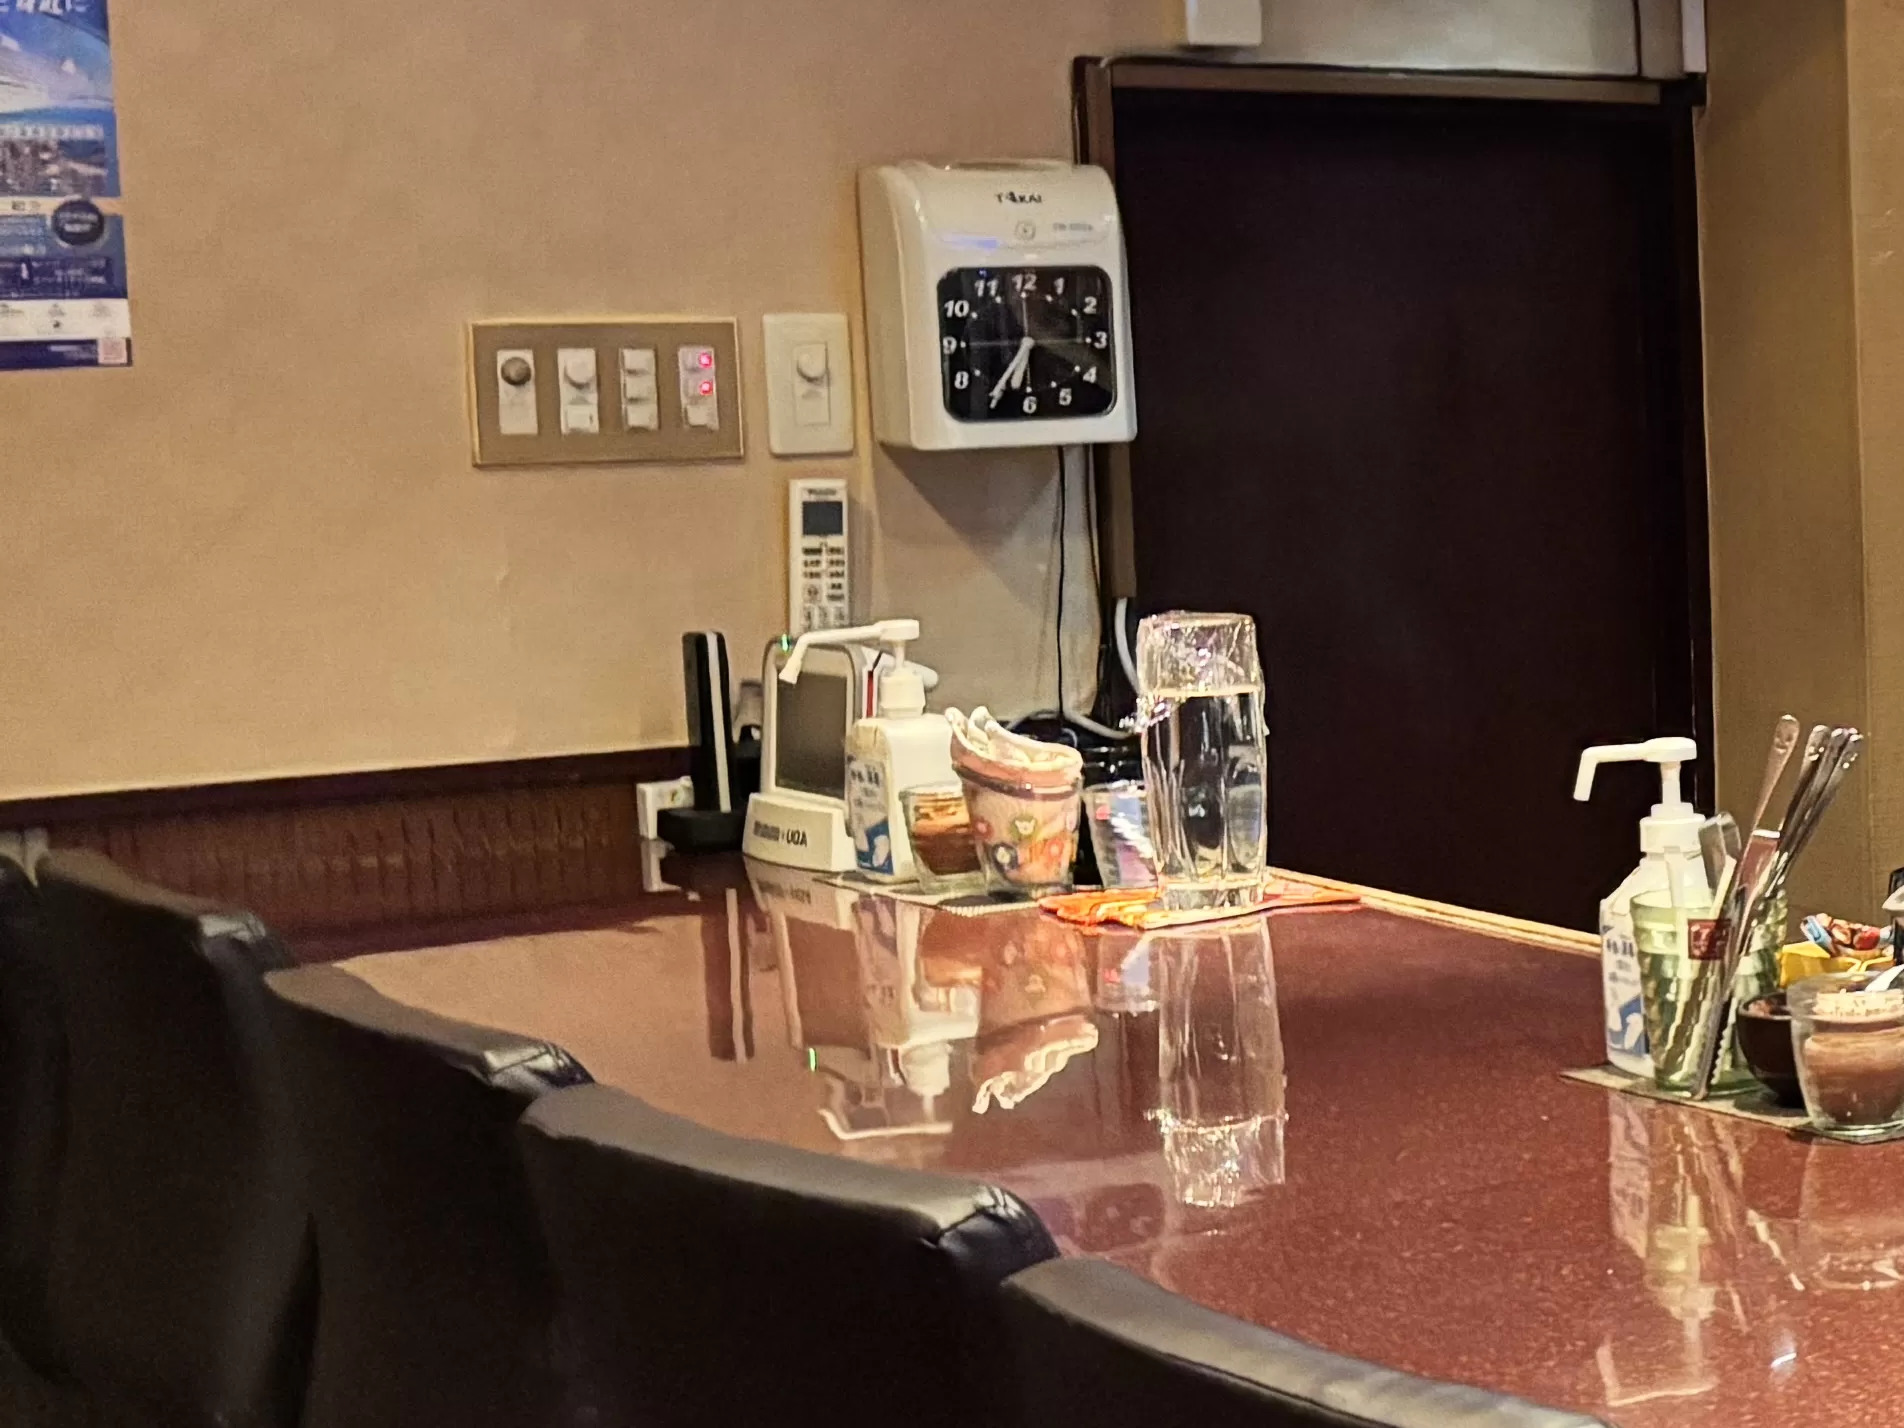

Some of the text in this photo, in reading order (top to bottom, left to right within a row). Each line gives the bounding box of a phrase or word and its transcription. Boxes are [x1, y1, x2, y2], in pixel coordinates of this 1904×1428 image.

[974, 279, 999, 298] 11
[1012, 274, 1037, 291] 12
[1053, 277, 1065, 295] 1
[944, 299, 970, 318] 10
[1083, 296, 1097, 314] 2
[942, 336, 957, 355] 9
[1093, 331, 1107, 349] 3
[954, 371, 969, 390] 8
[1082, 366, 1097, 384] 4
[1022, 396, 1037, 414] 6
[1058, 387, 1072, 406] 5
